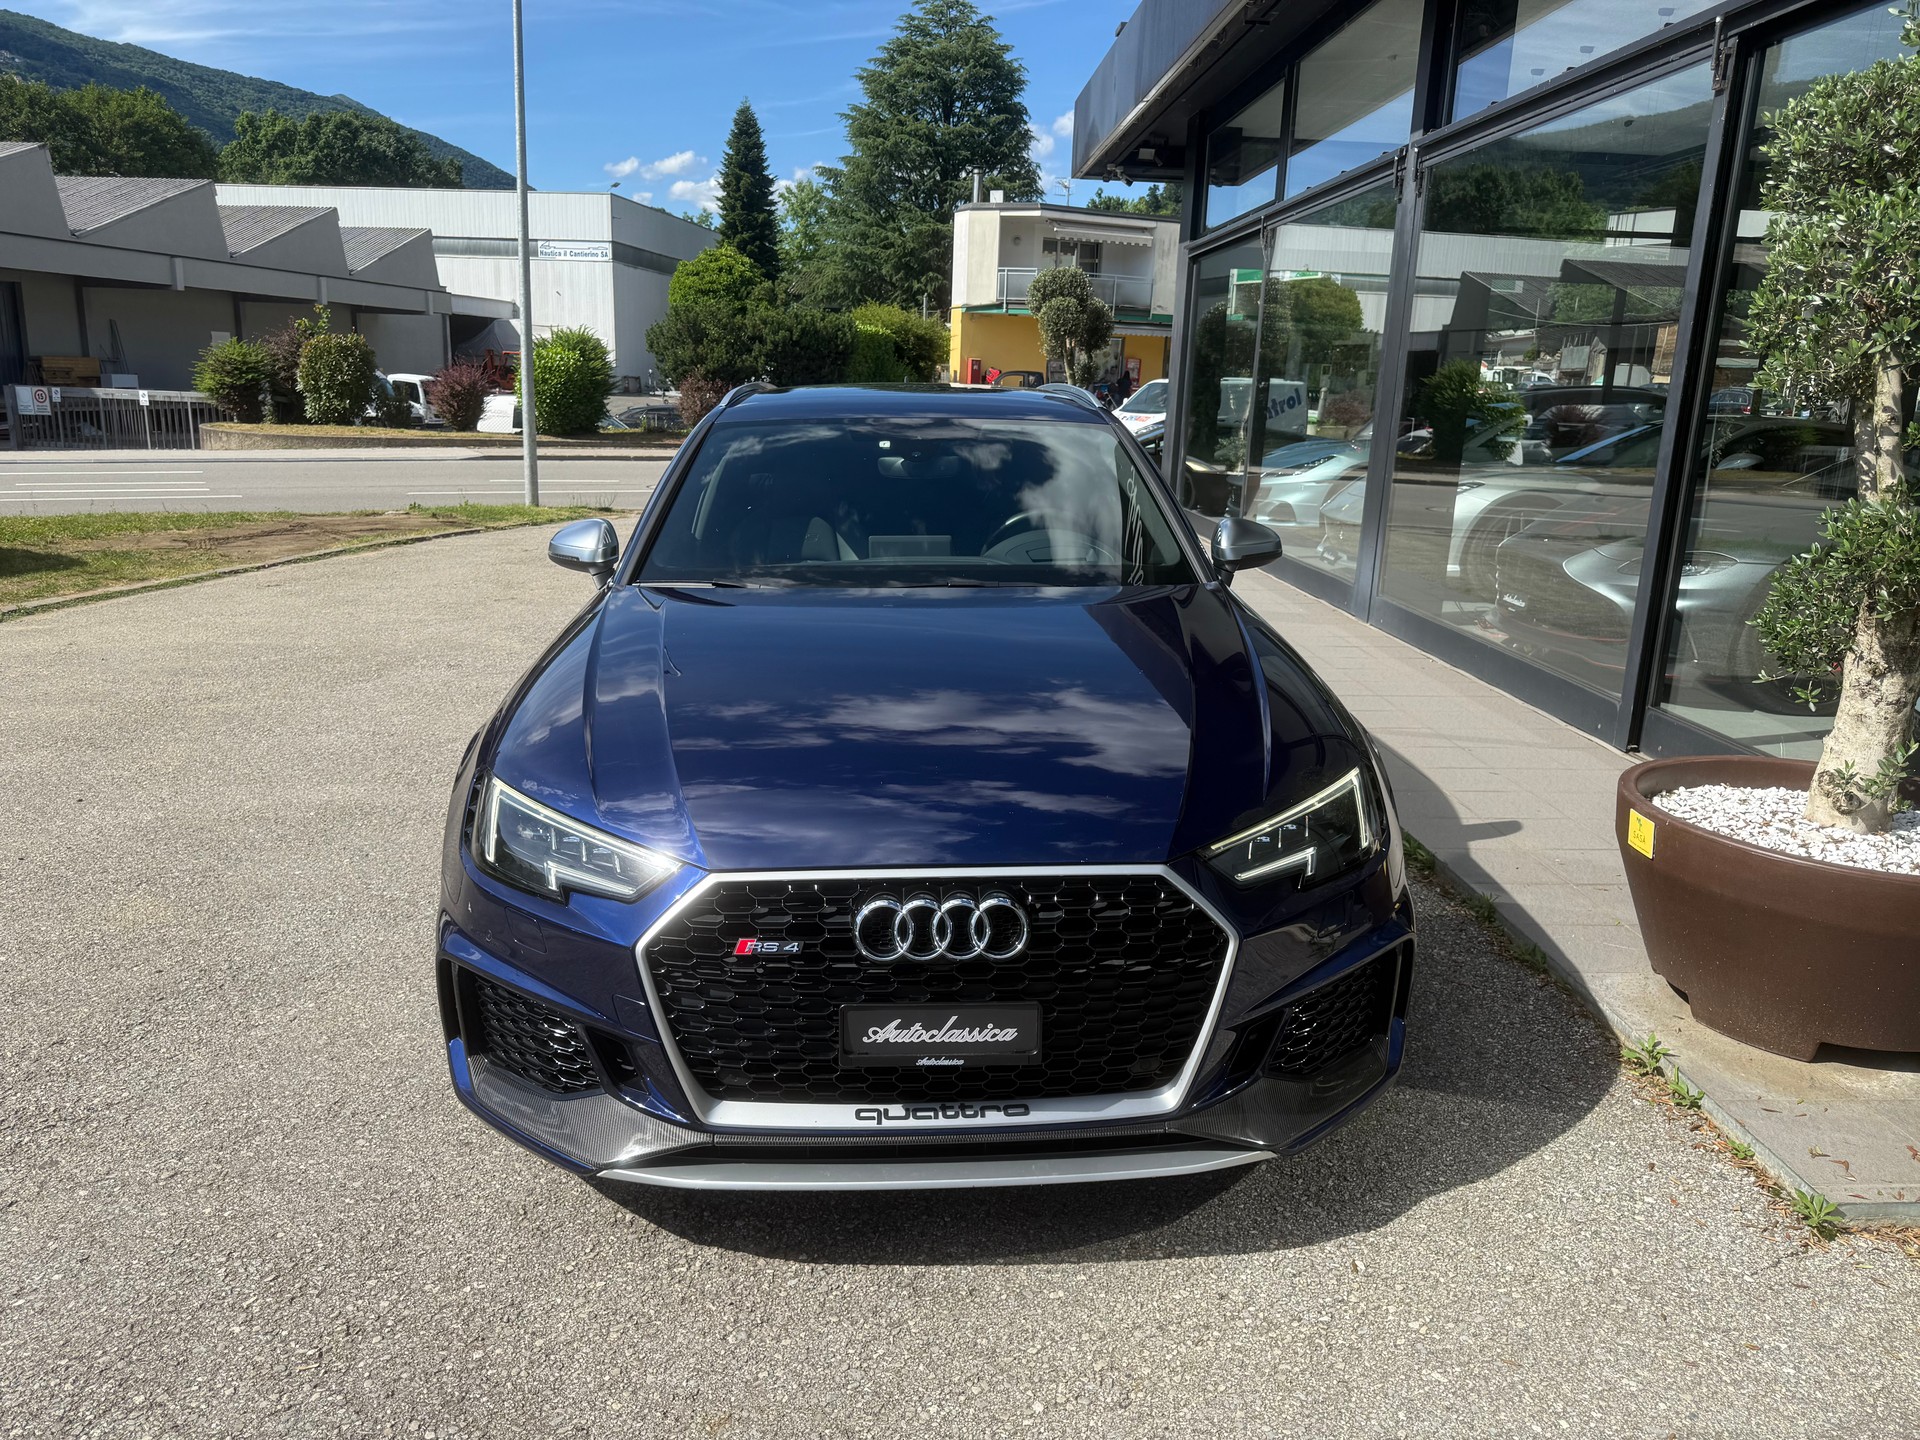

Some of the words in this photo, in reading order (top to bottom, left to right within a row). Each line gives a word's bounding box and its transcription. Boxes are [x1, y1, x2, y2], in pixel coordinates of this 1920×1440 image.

[744, 942, 779, 952] RS
[783, 942, 799, 953] 4
[862, 1015, 1019, 1043] Autoclassica
[915, 1056, 965, 1066] Autoclassica
[855, 1102, 1031, 1125] quattro
